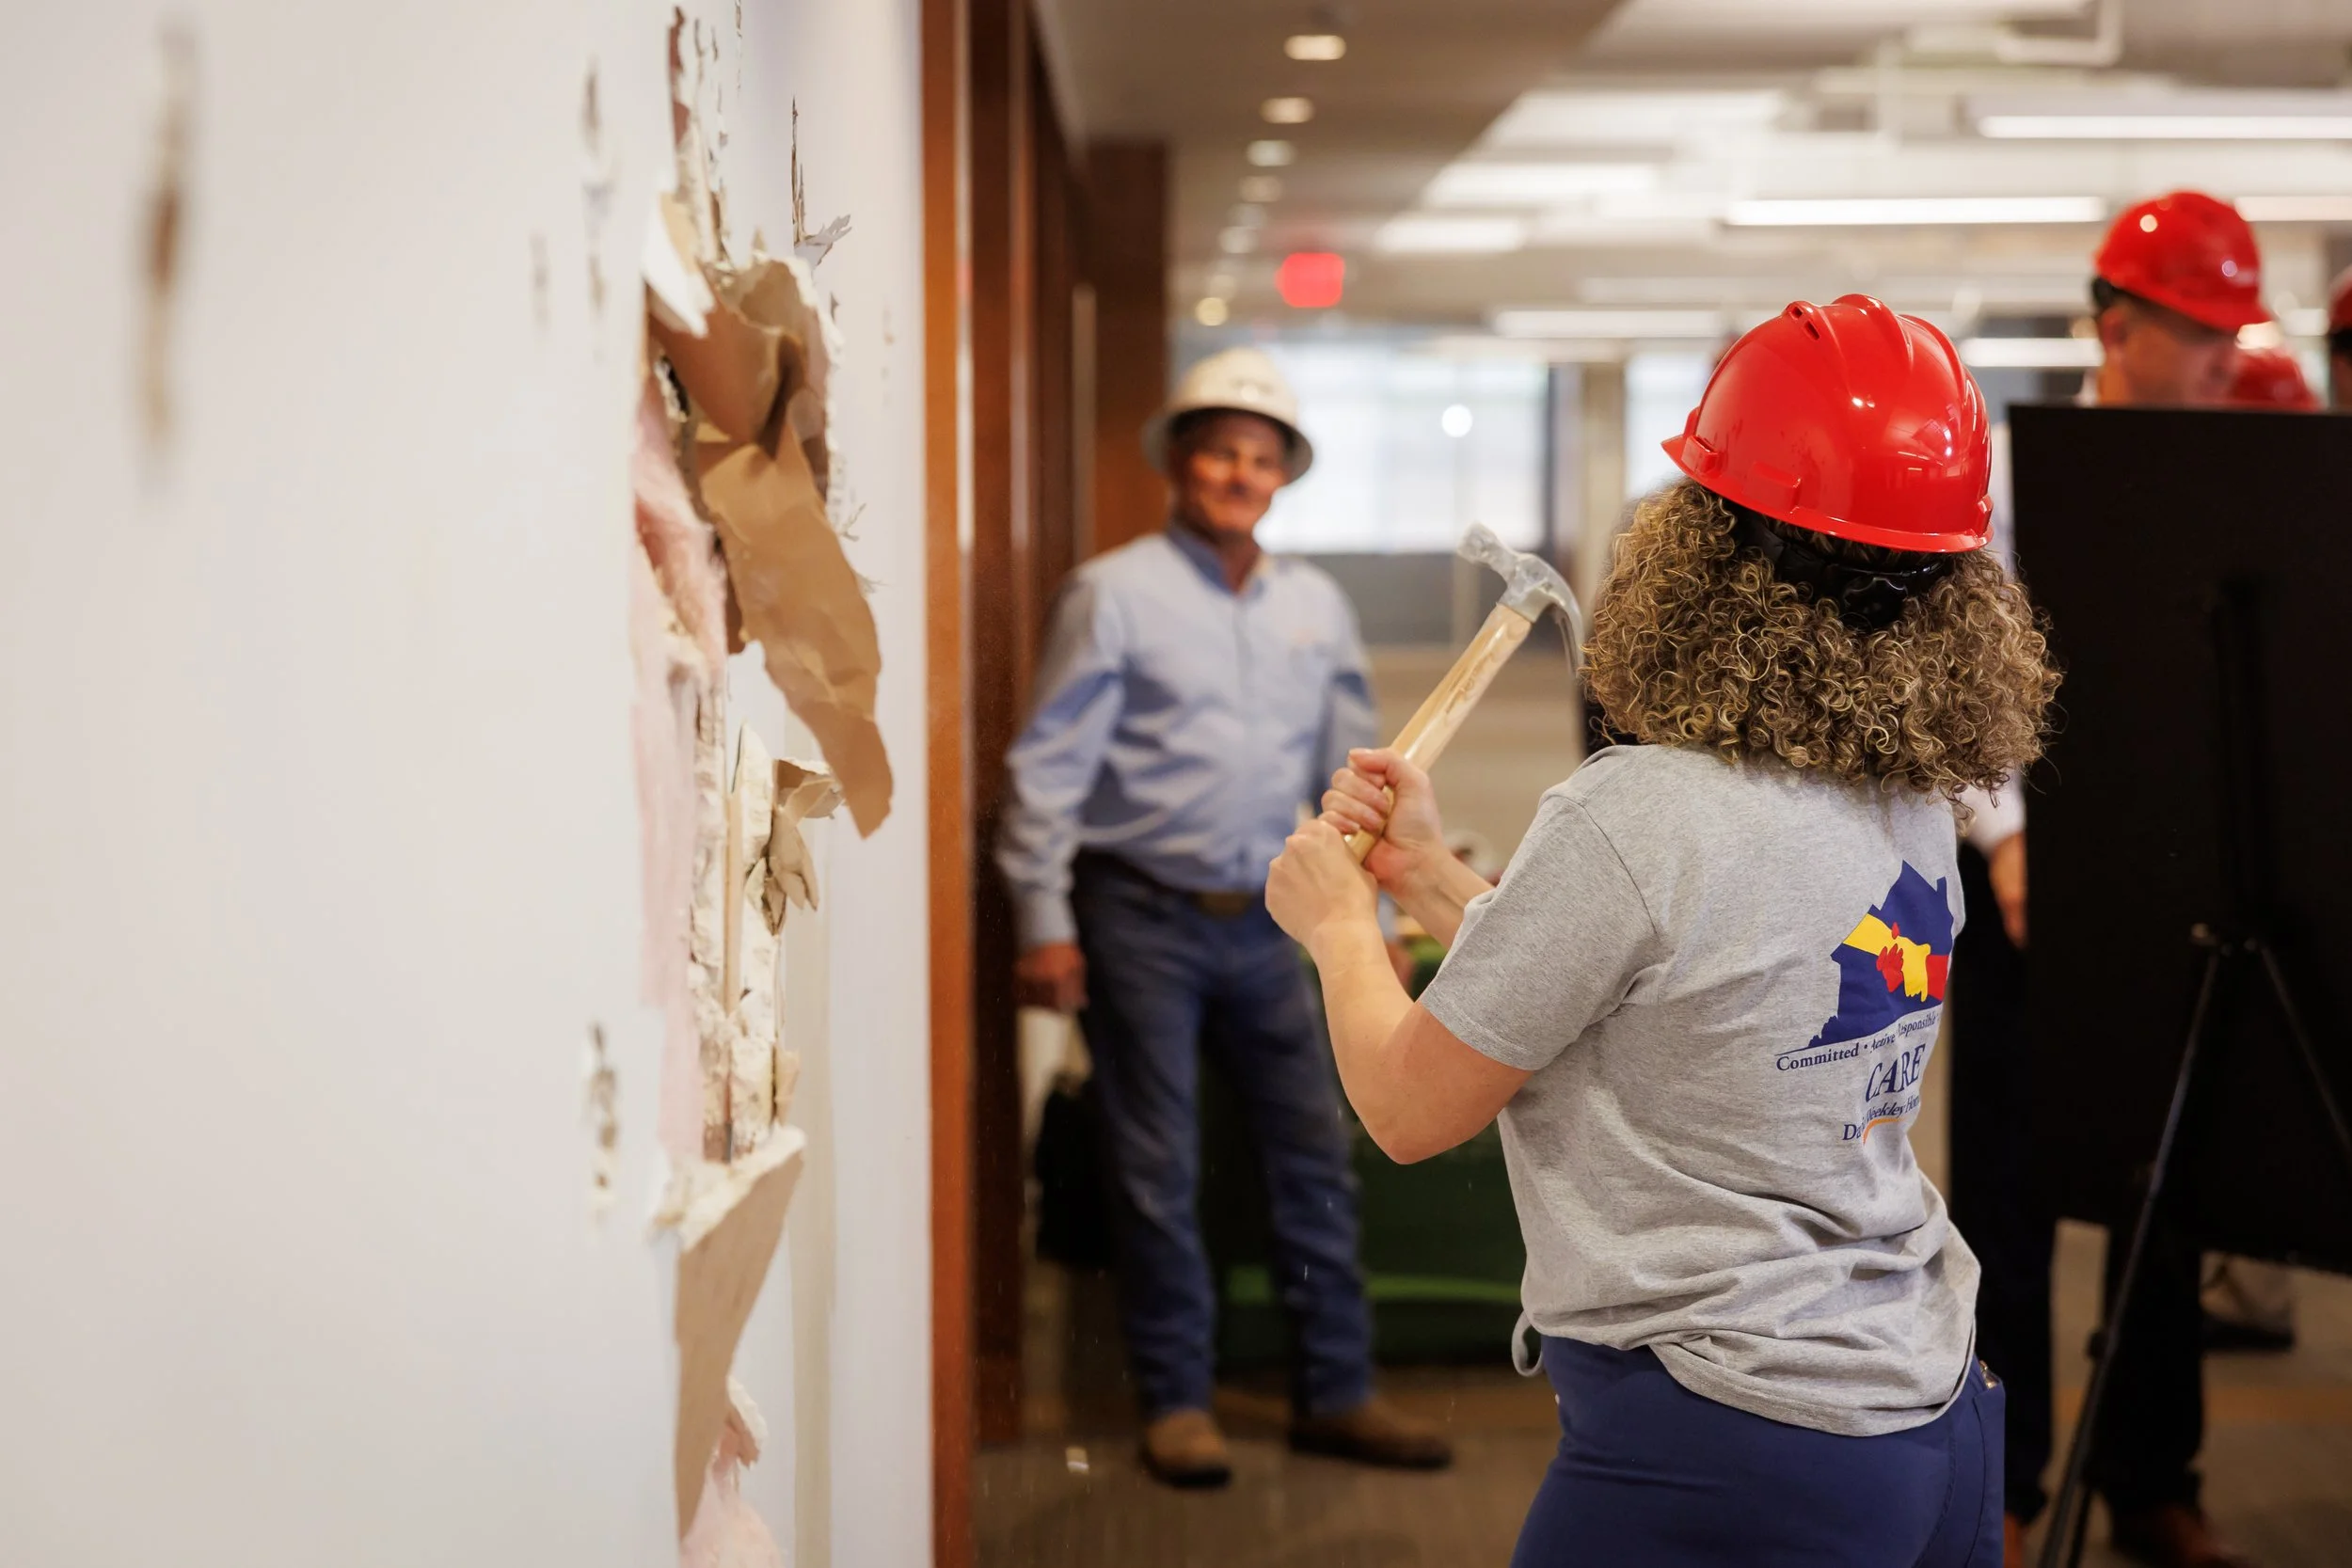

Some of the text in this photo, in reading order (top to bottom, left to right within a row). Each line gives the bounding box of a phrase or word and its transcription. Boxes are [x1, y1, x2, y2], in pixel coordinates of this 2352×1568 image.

[1776, 1043, 1859, 1070] Committed
[1870, 1033, 1896, 1053] Active
[1865, 1043, 1926, 1102] CARE
